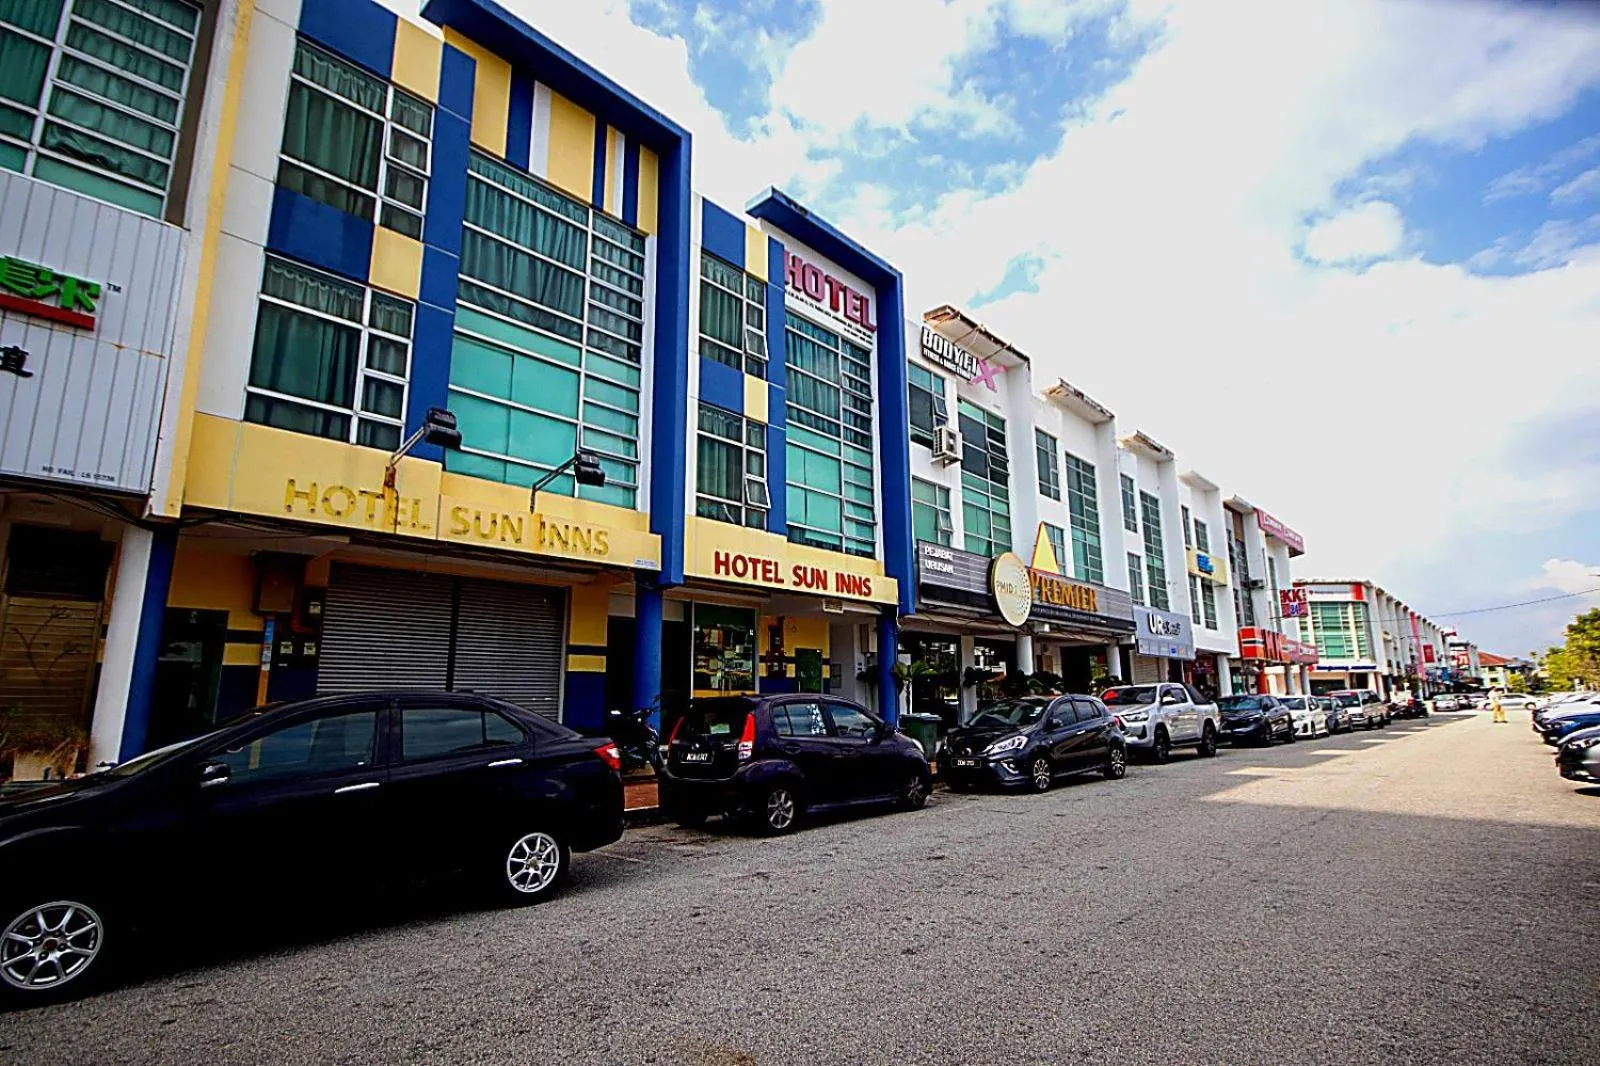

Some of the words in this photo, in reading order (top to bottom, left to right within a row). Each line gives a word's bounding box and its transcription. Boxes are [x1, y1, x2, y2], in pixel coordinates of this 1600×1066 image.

[107, 282, 122, 293] TM
[784, 250, 877, 332] HOTEL
[283, 478, 432, 530] HOTEL
[450, 505, 523, 545] SUN
[539, 521, 610, 557] INNS
[714, 551, 784, 584] HOTEL
[792, 565, 828, 591] SUN
[835, 572, 872, 597] INNS
[1030, 571, 1099, 613] PREMIER
